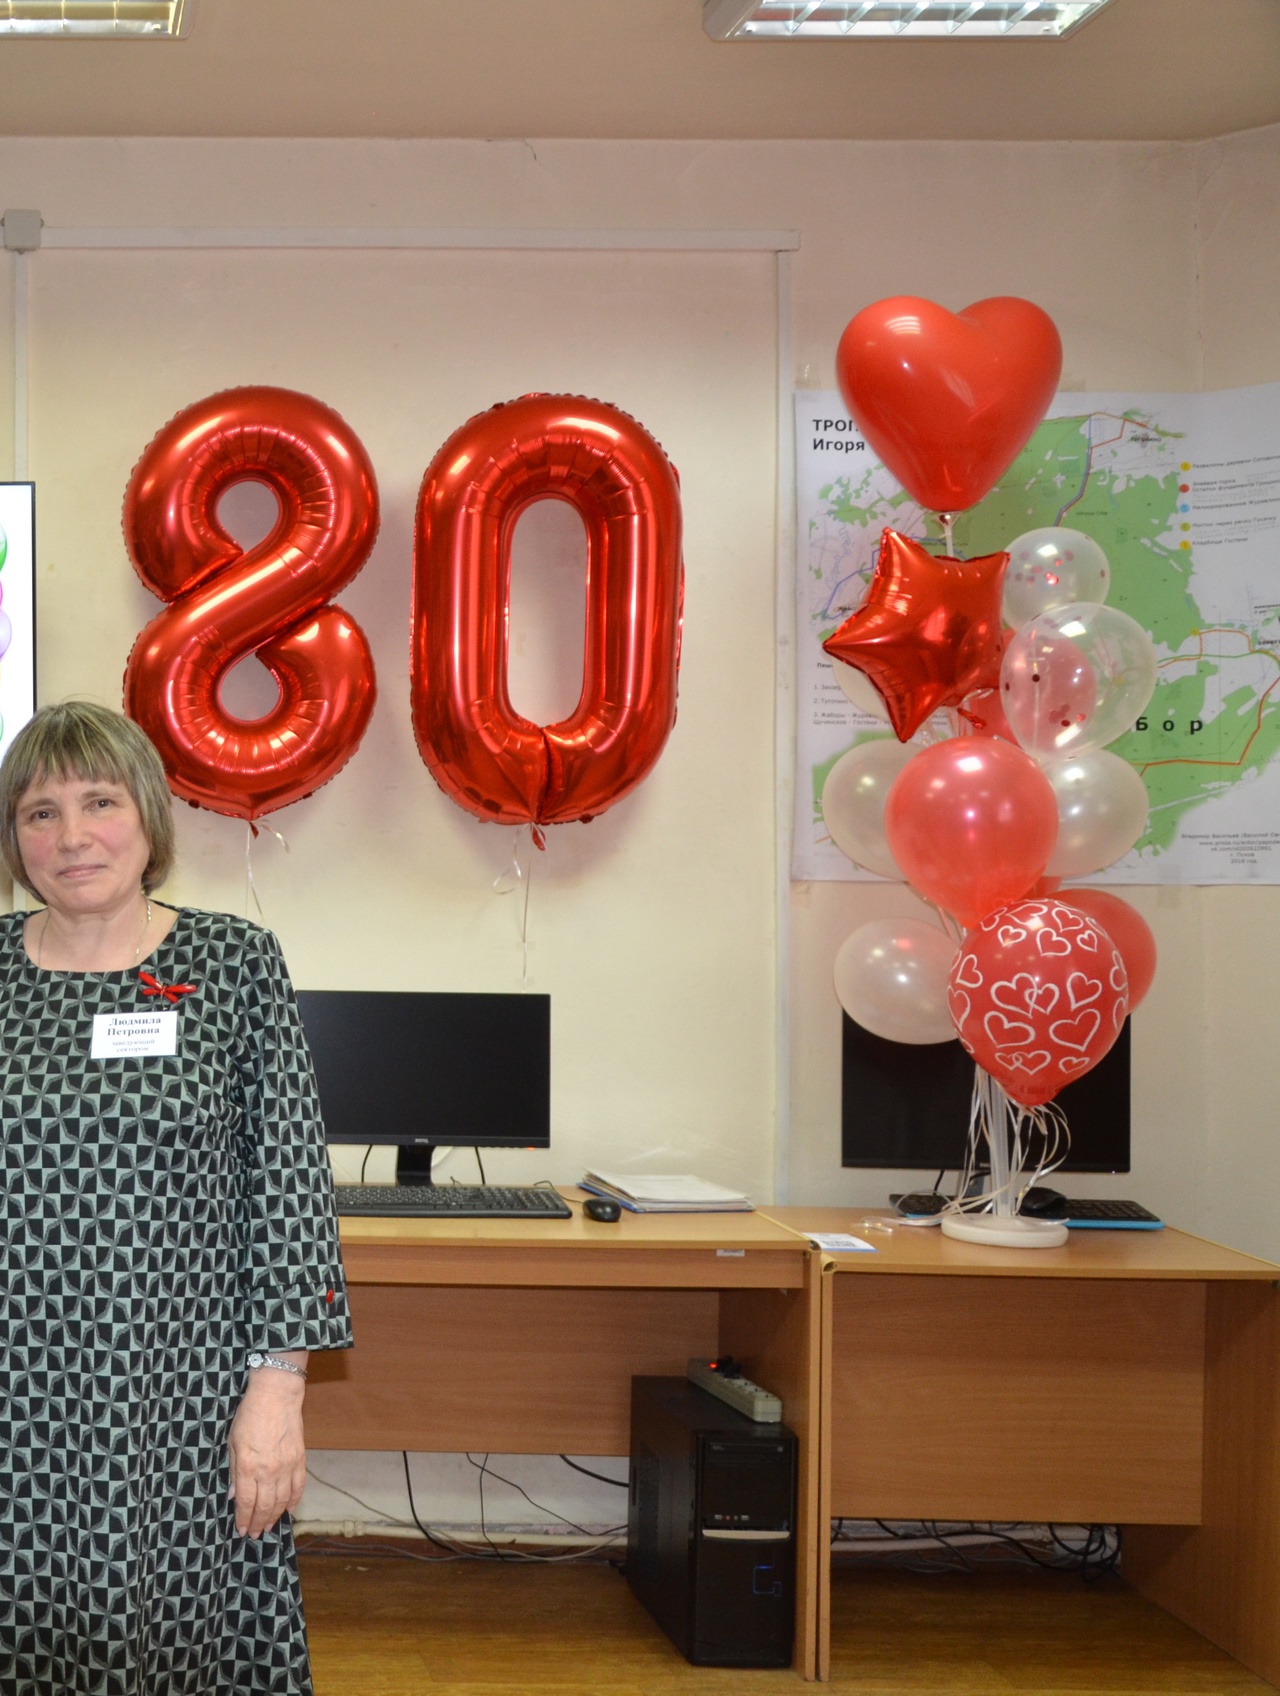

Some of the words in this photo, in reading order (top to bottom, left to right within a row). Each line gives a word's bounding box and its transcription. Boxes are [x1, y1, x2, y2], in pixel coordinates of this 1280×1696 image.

[813, 438, 865, 454] Игоря
[108, 1017, 162, 1026] Людмила
[107, 1028, 160, 1037] Петровна
